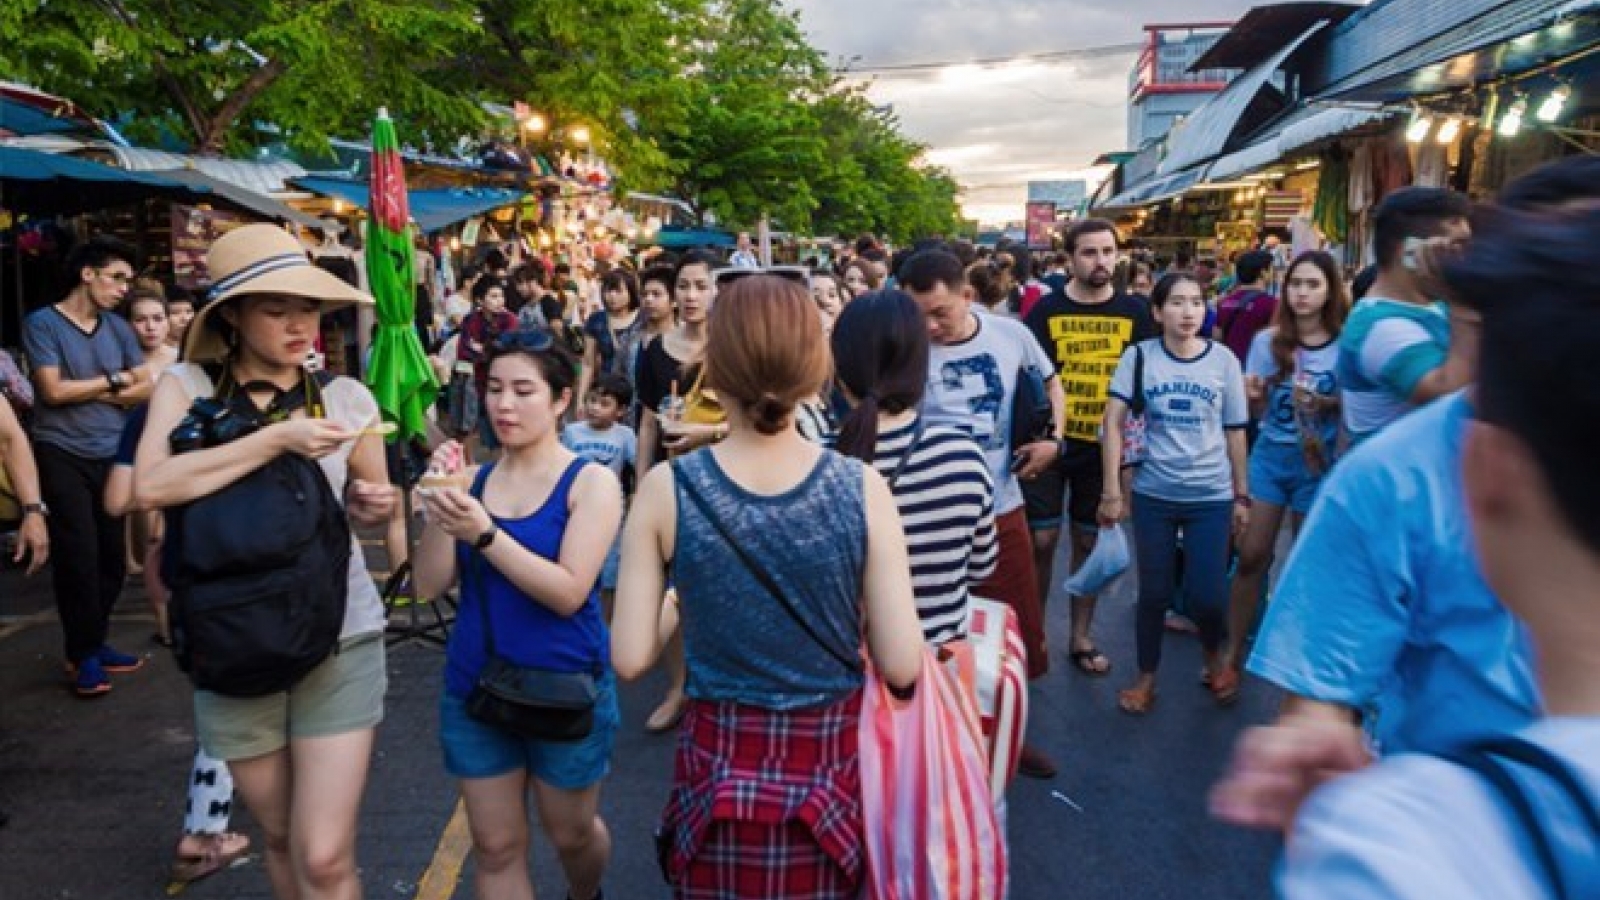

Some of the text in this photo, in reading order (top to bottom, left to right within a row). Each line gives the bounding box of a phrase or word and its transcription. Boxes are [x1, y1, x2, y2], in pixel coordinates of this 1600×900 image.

[1061, 318, 1121, 335] BANGKOK
[1066, 338, 1111, 356] PATTAYA
[1144, 381, 1218, 406] MAHIDOL
